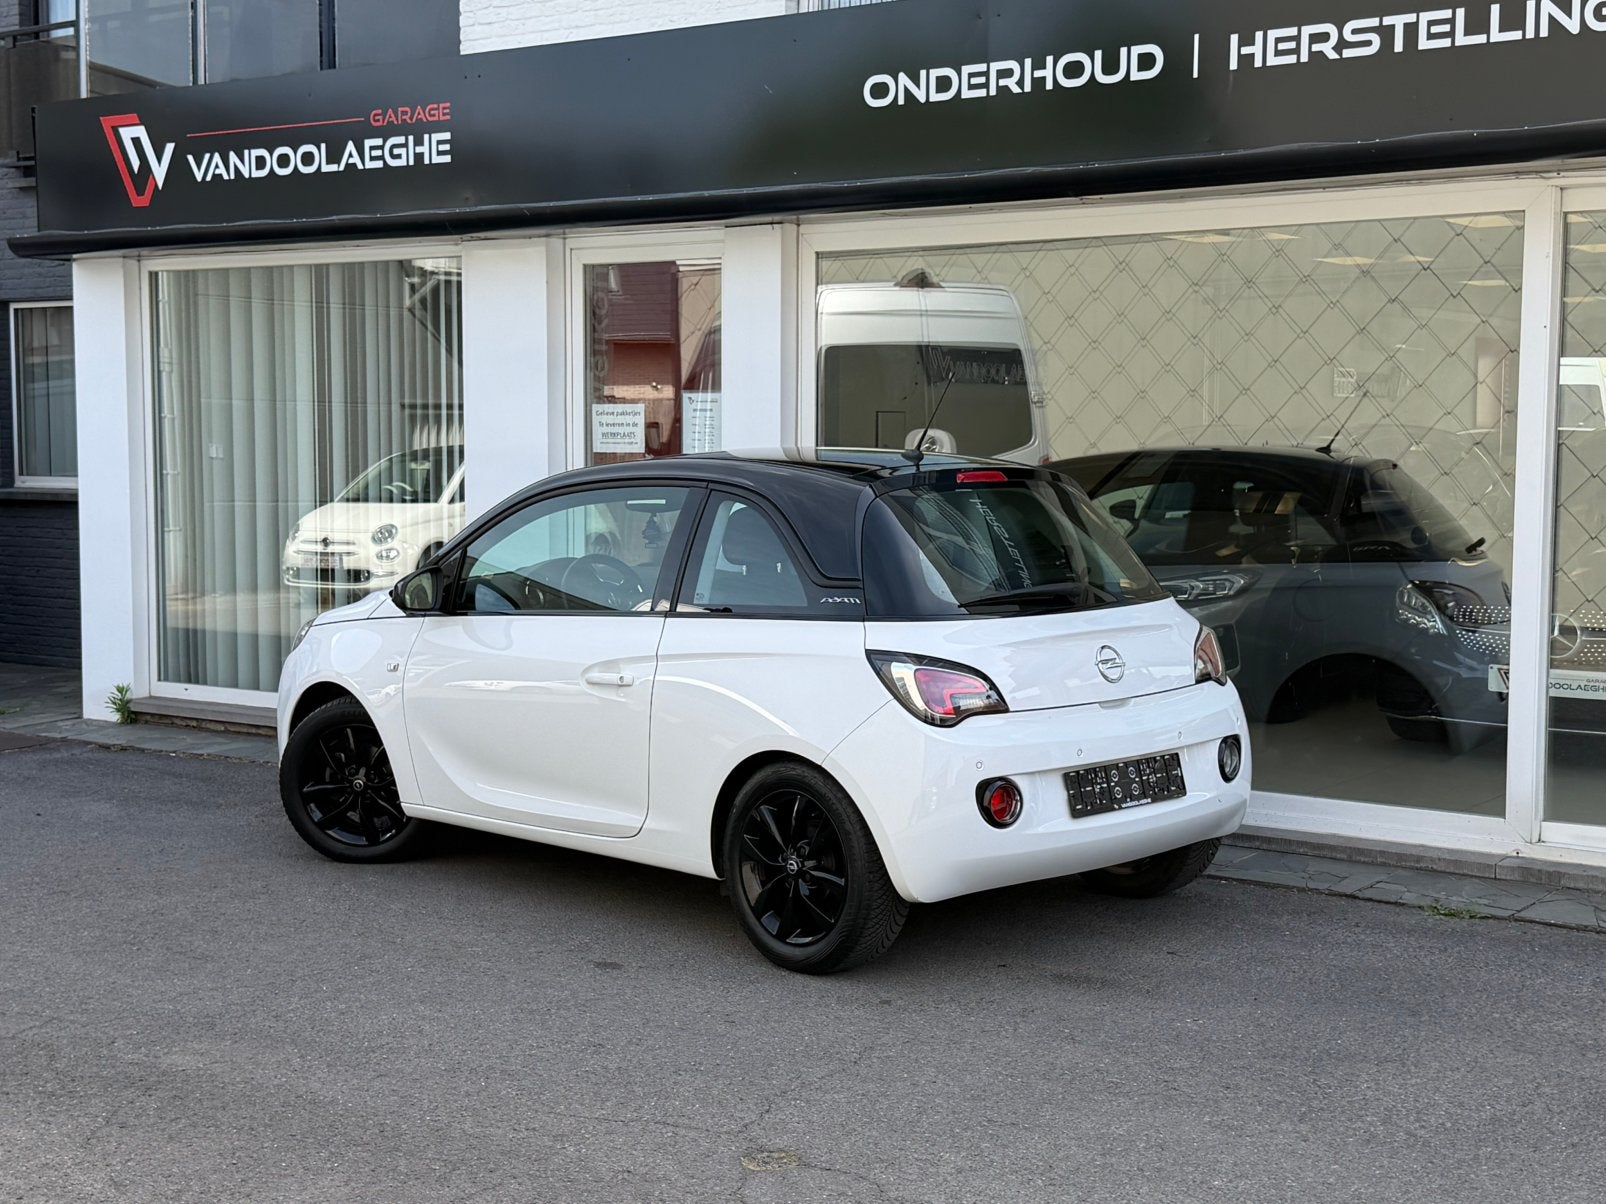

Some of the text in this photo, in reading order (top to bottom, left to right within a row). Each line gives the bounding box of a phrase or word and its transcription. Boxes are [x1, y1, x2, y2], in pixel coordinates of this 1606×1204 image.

[863, 0, 1606, 109] ONDERHOUD HERSTELLING
[370, 102, 451, 127] GARAGE
[186, 131, 452, 183] VANDOOLAEGHE
